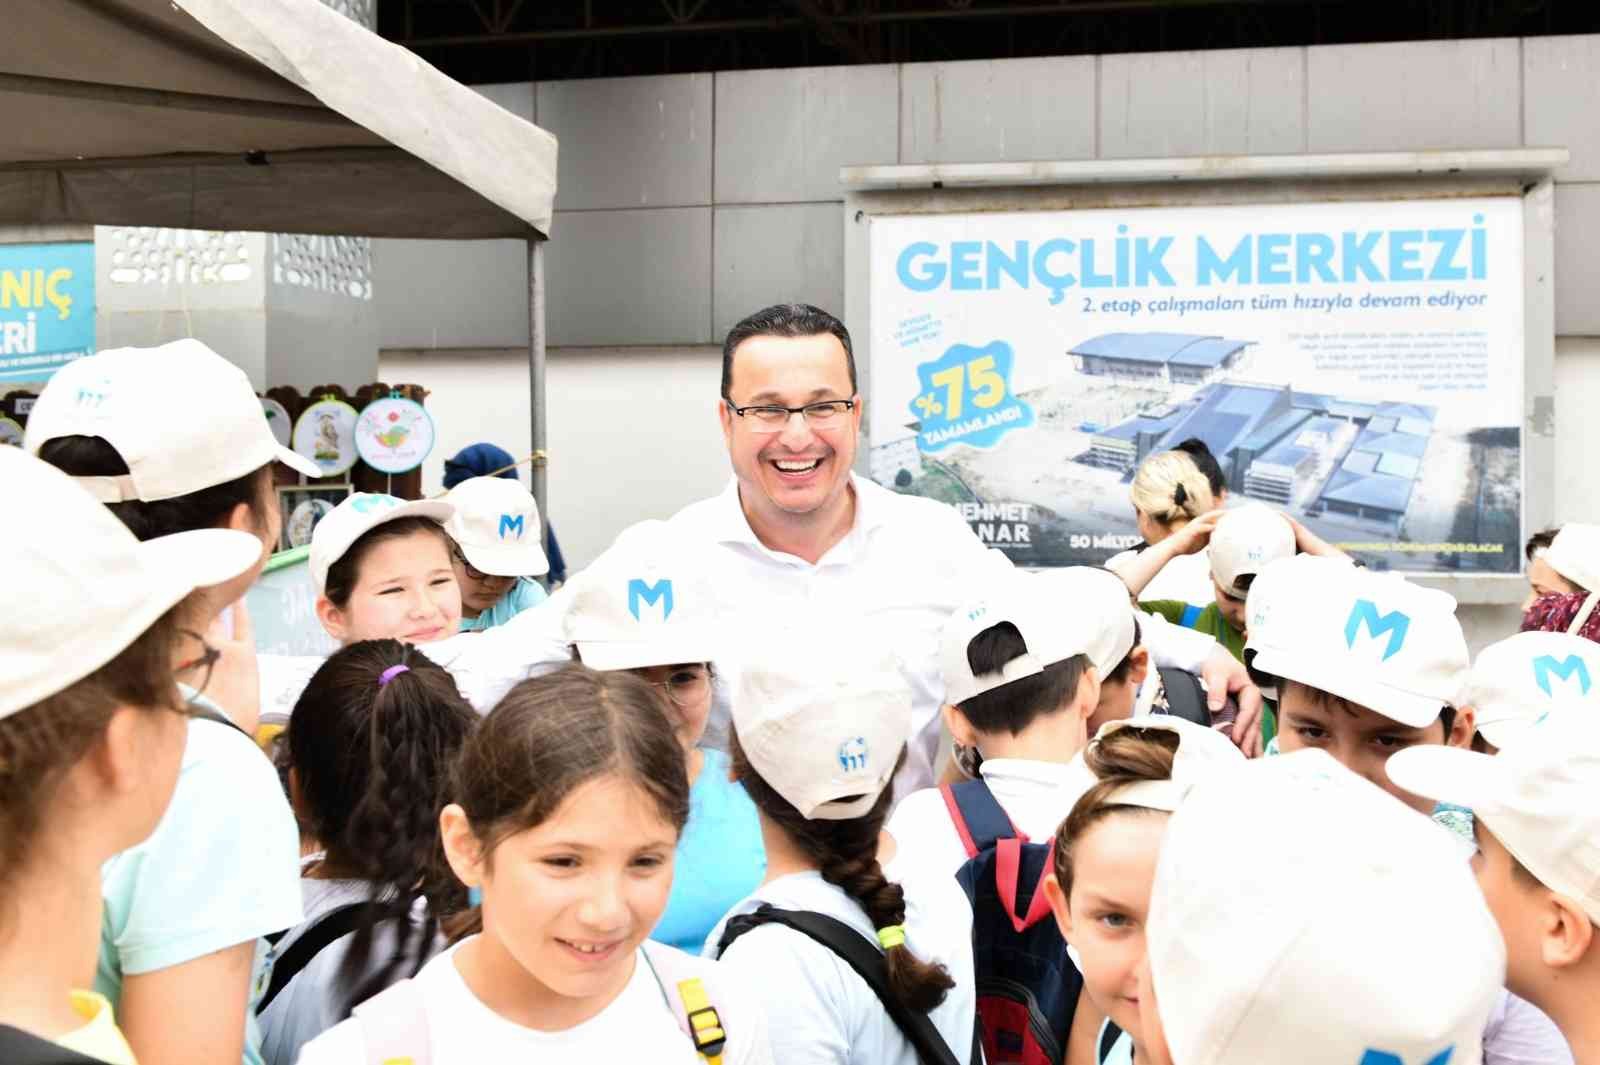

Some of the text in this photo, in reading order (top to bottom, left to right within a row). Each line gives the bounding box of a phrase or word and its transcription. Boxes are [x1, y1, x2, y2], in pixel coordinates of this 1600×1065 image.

[896, 213, 1487, 306] GENÇLİK MERKEZİ
[1082, 290, 1487, 317] 2. etap çalışmaları tüm hızıyla devam ediyor
[0, 311, 36, 354] Rİ
[922, 405, 1022, 445] TAMAMLANDI
[957, 503, 1032, 521] EHMET
[978, 523, 1030, 542] NAR
[628, 578, 674, 623] M
[1344, 598, 1411, 662] M
[1532, 654, 1593, 699] M
